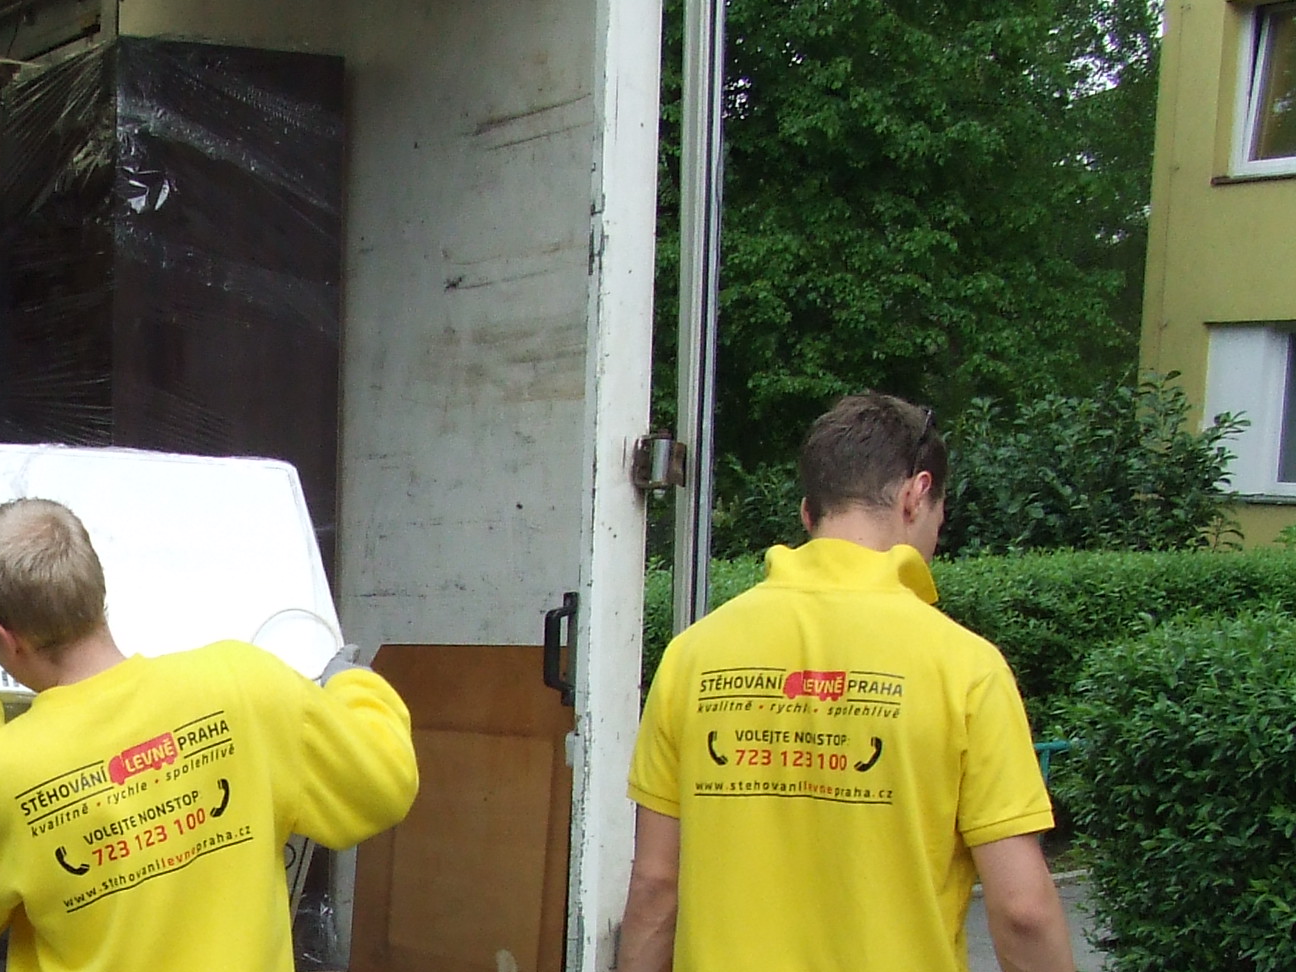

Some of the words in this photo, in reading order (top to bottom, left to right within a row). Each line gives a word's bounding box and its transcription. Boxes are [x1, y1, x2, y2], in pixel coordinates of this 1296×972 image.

[700, 673, 784, 693] STĚHOVÁNÍ
[803, 675, 844, 694] LEVNĚ
[847, 679, 902, 697] PRAHA
[697, 700, 753, 714] kvalitně
[735, 729, 791, 745] VOLEJTE
[20, 765, 108, 816] STĚHOVÁNÍ
[124, 738, 175, 773] LEVNĚ
[177, 719, 230, 751] PRAHA
[735, 749, 772, 766] 723
[781, 750, 812, 768] 123
[817, 753, 848, 771] 100
[31, 802, 89, 838] kvalitně
[107, 780, 148, 805] rychle
[165, 743, 235, 782] spolehlivě
[83, 814, 138, 846] VOLEJTE
[138, 790, 200, 826] NONSTOP
[92, 839, 131, 866] 723
[134, 825, 168, 851] 123
[173, 807, 206, 836] 100
